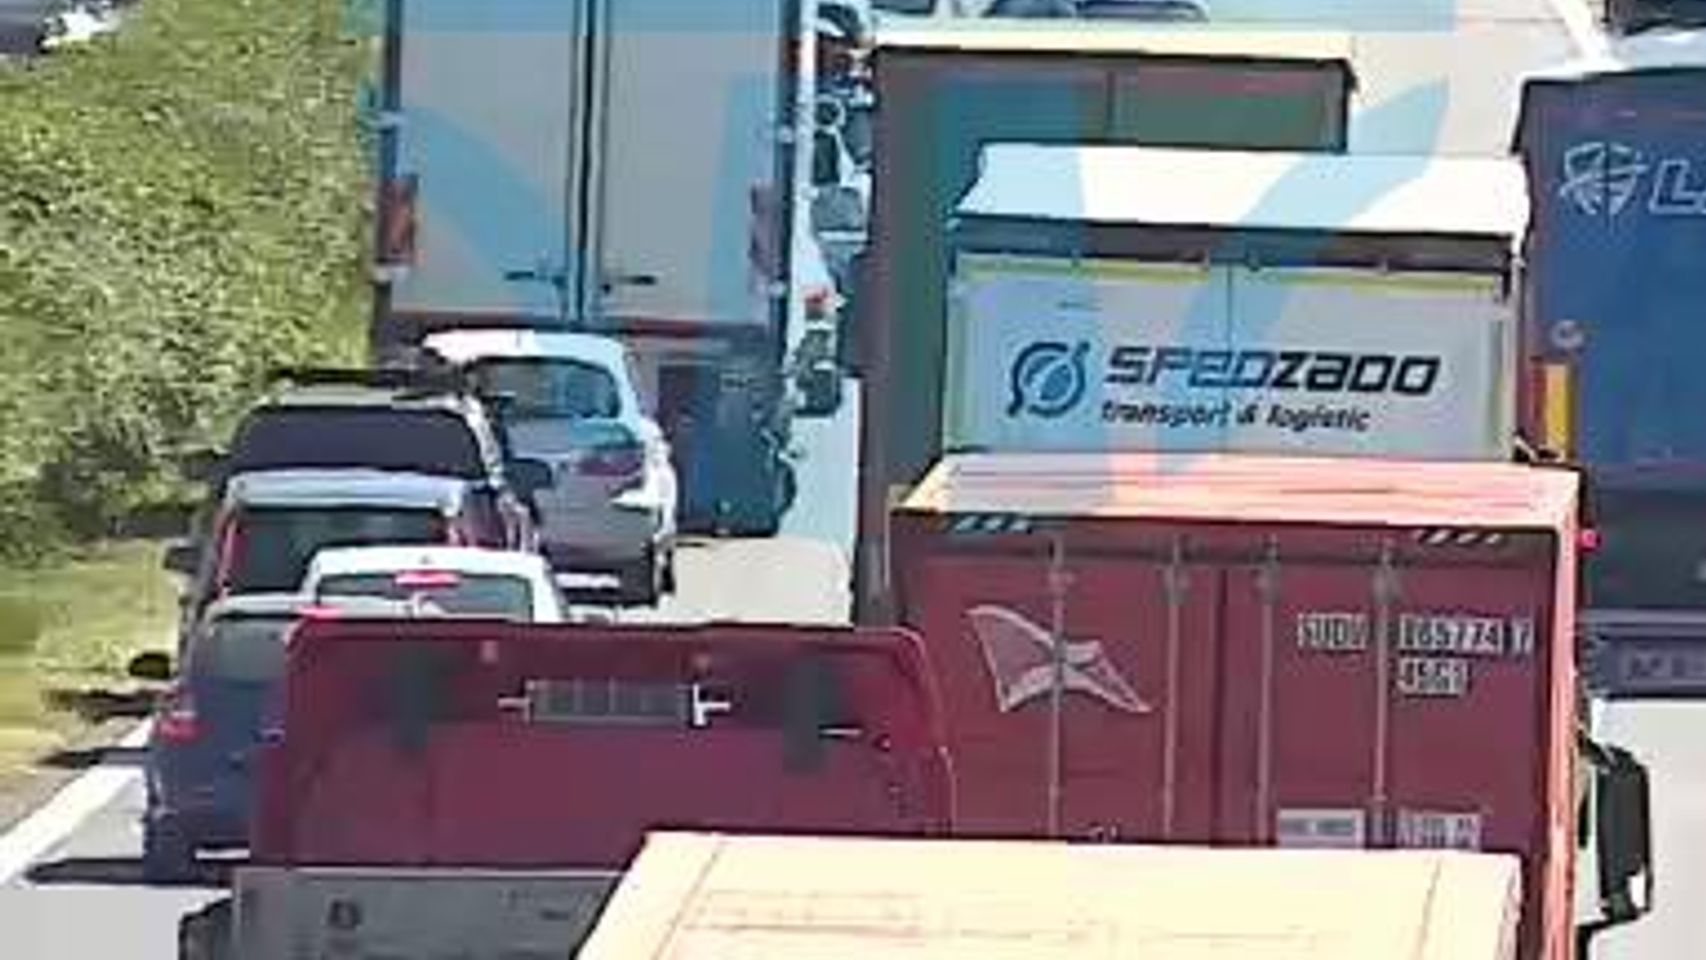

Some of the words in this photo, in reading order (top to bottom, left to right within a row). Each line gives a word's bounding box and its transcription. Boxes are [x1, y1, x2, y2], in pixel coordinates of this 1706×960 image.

[1102, 399, 1231, 430] transport
[1236, 402, 1259, 425] &
[1266, 404, 1372, 433] logistic
